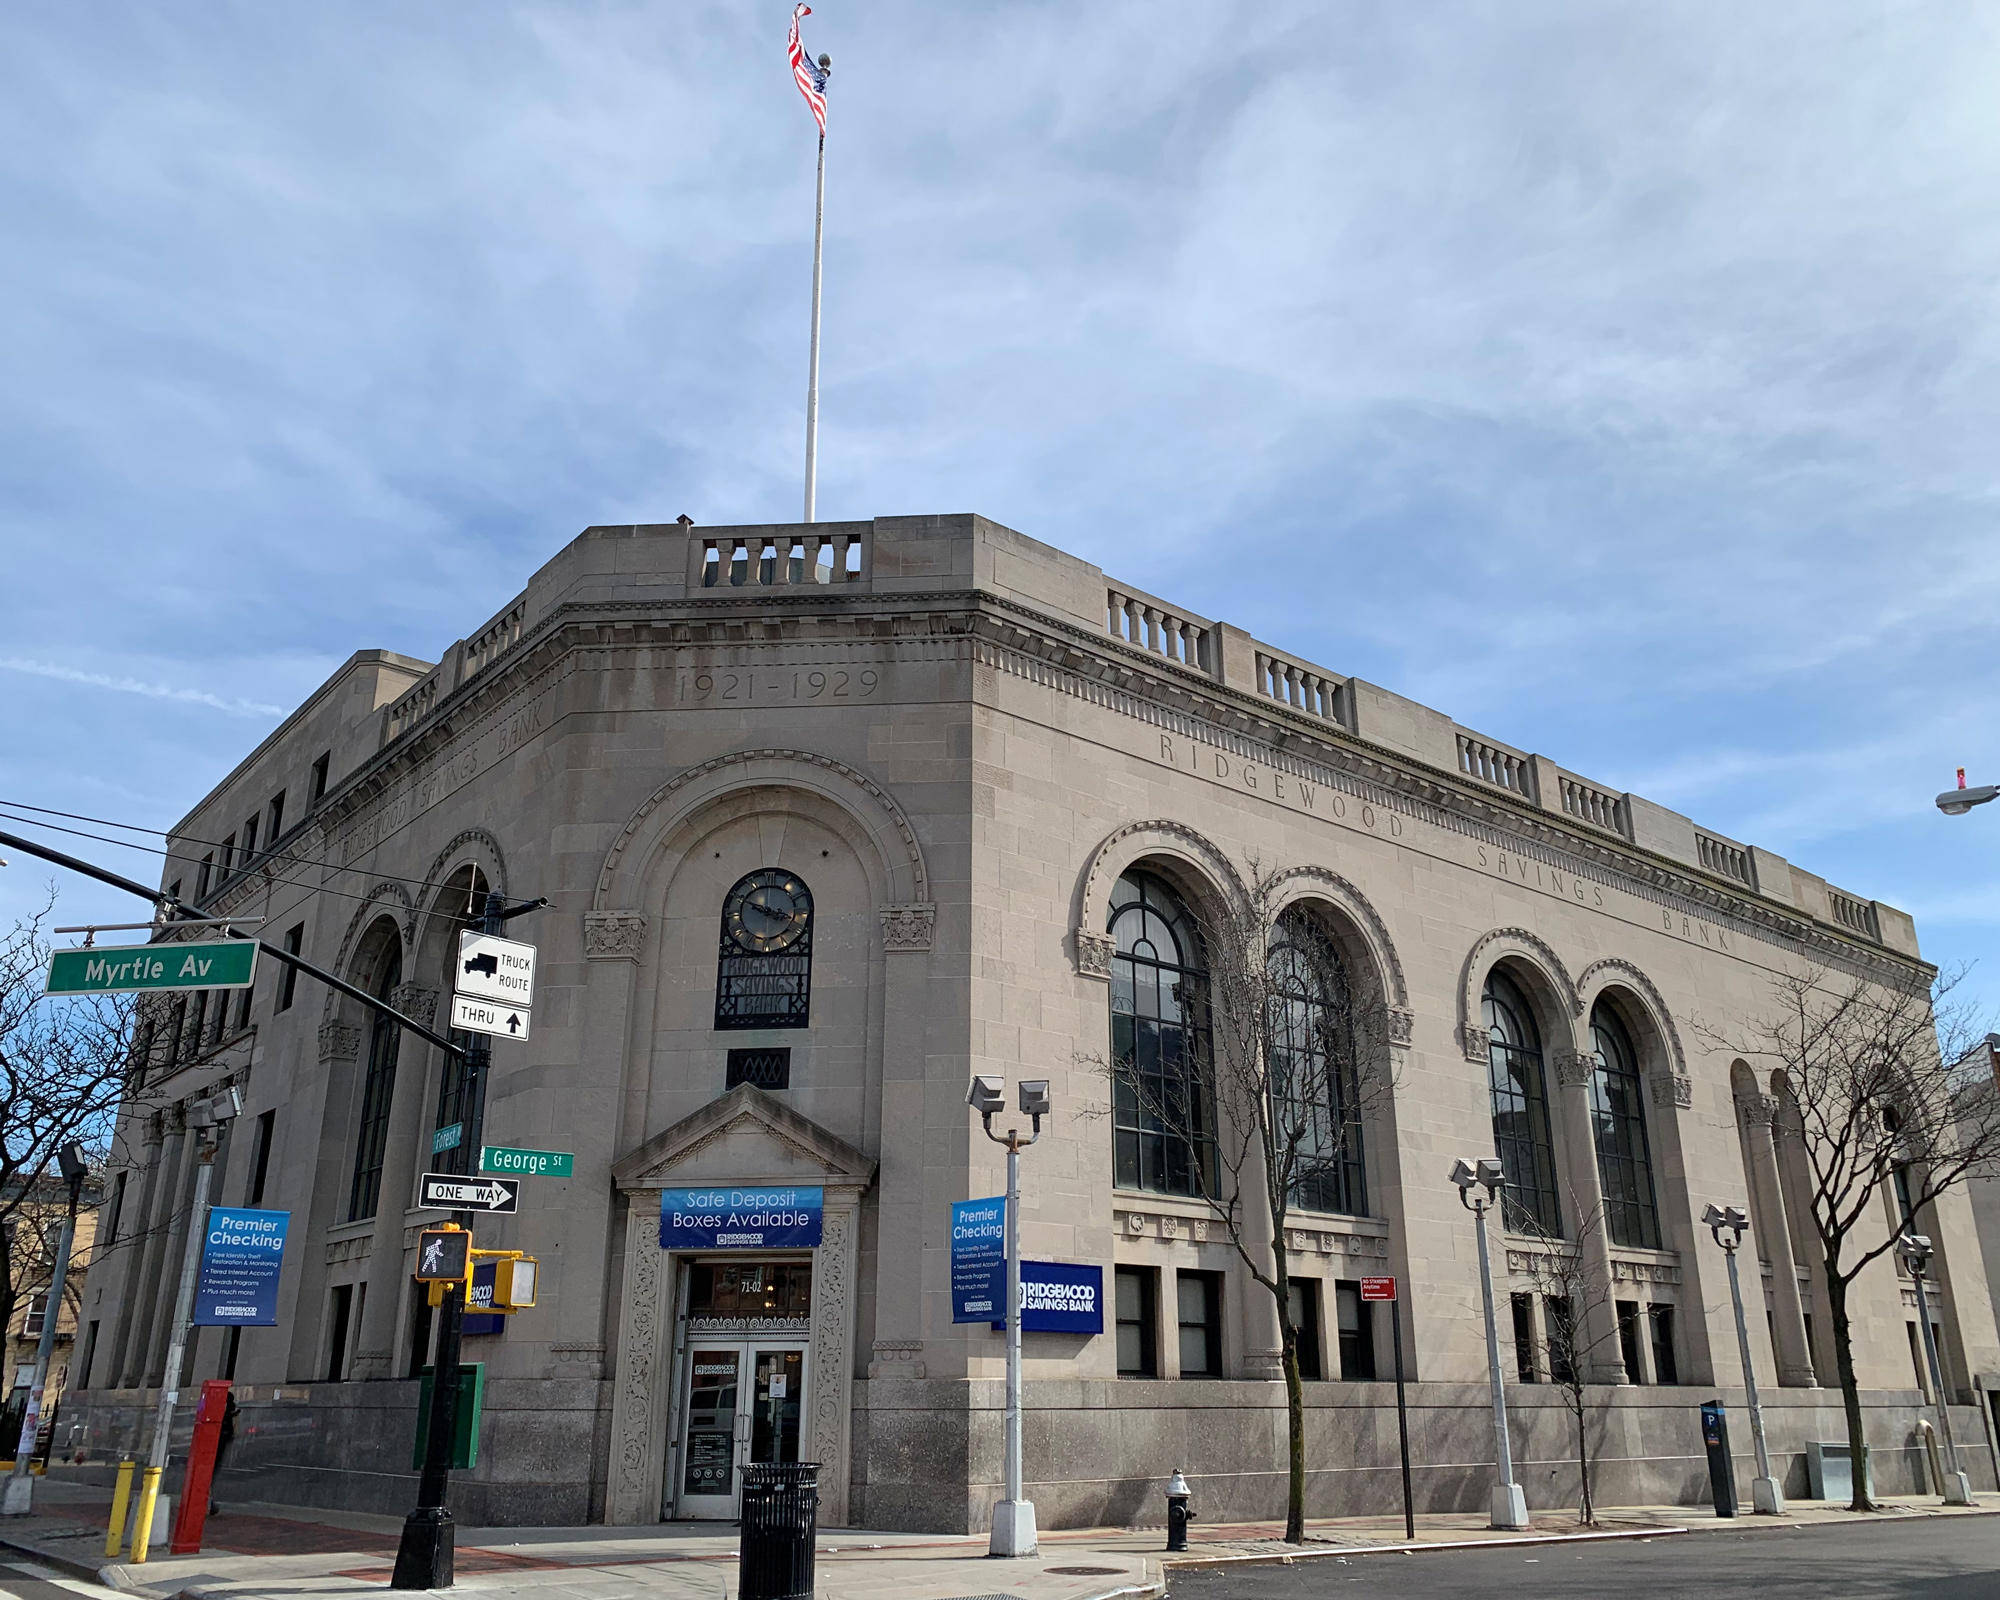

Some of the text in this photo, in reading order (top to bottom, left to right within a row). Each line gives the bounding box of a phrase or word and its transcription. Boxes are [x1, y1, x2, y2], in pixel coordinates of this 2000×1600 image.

[497, 700, 544, 756] BANK
[1160, 734, 1729, 950] RIDGEWOOD SAVINGS BANK
[85, 954, 212, 987] Myrtle Av
[502, 954, 530, 971] TRUCK
[499, 975, 529, 991] ROUTE
[734, 976, 795, 995] SAVINGS
[744, 995, 785, 1014] BANK
[461, 1006, 494, 1024] THRU
[435, 1127, 456, 1151] Forest
[493, 1150, 562, 1174] George St
[435, 1185, 503, 1202] ONE WAY
[686, 1190, 796, 1210] Safe Deposit
[220, 1216, 278, 1232] Premier
[673, 1210, 809, 1228] Boxes Available
[959, 1208, 998, 1223] Premier
[953, 1224, 1003, 1239] Checking
[209, 1232, 283, 1250] Checking
[249, 1260, 278, 1268] Monitoring
[233, 1279, 259, 1287] Programs
[741, 1281, 762, 1293] 71-02
[1027, 1282, 1095, 1300] RIDGEWOOD
[1027, 1298, 1095, 1312] SAVINGS BANK
[1707, 1415, 1715, 1426] P
